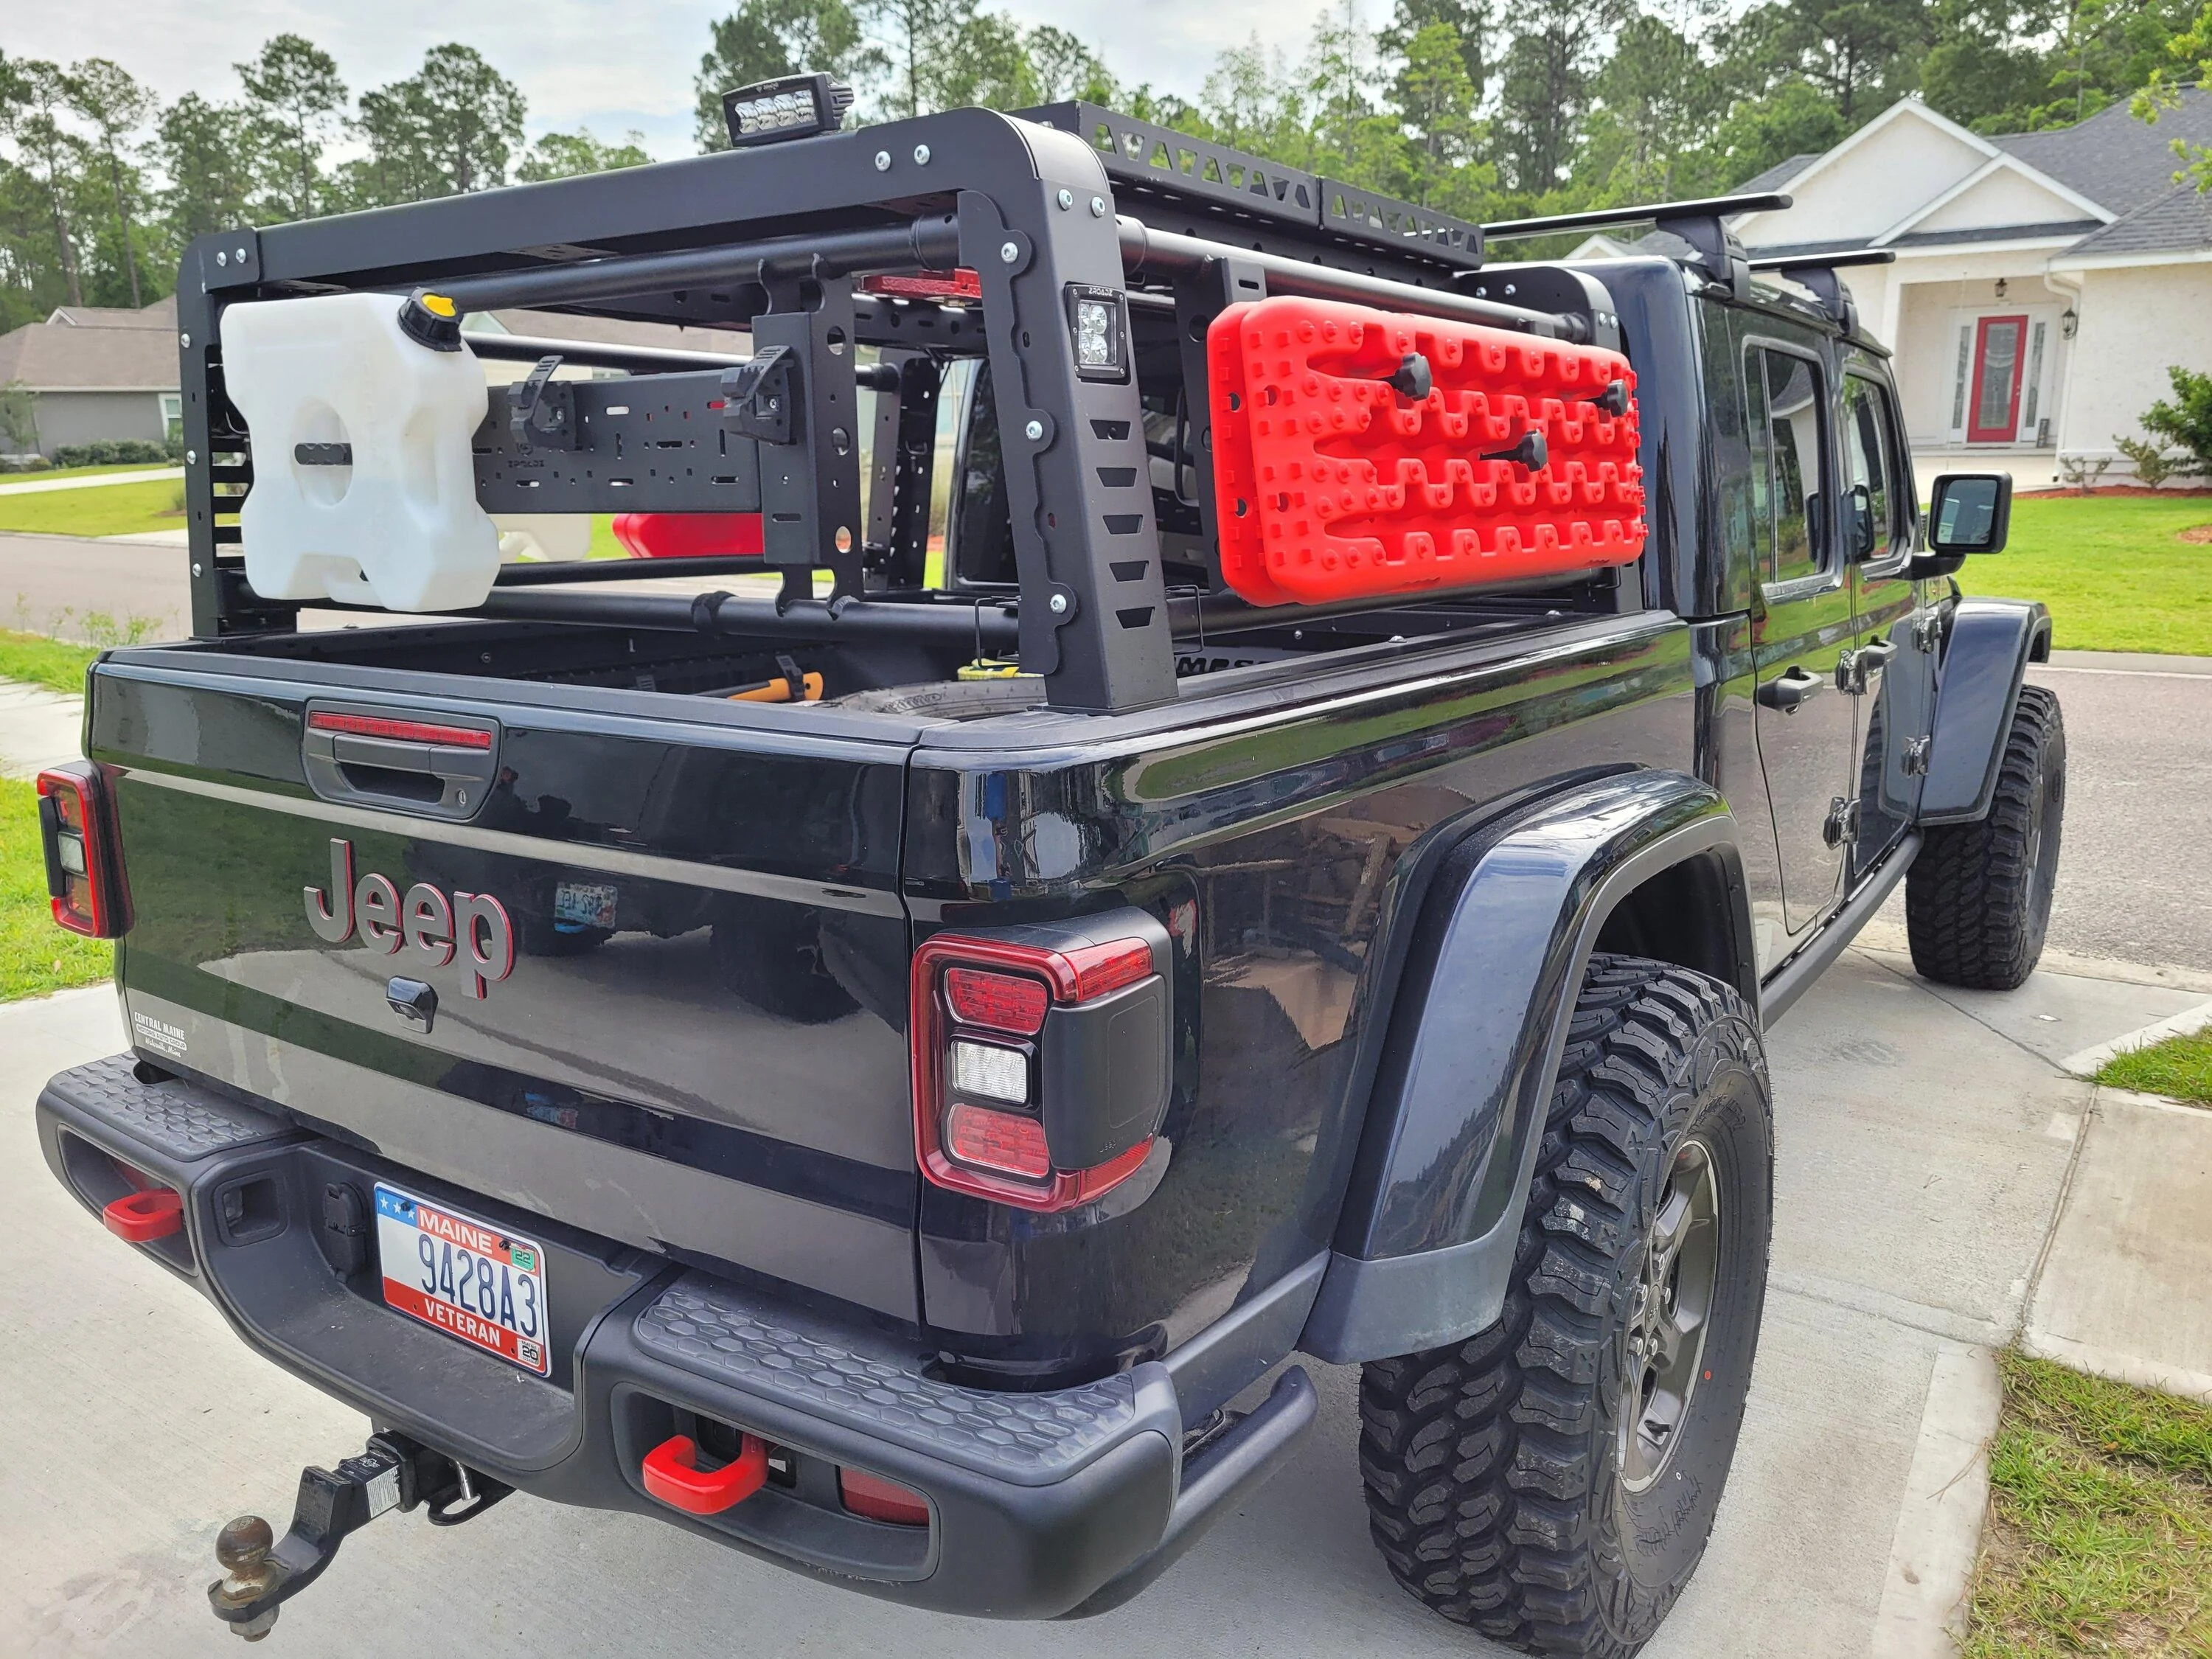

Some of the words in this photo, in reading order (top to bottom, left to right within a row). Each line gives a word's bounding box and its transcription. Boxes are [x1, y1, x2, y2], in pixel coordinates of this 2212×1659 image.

[303, 838, 514, 1001] Jeep
[134, 1011, 162, 1032] CENTRAL
[162, 1023, 185, 1040] MAINE
[419, 1208, 493, 1255] MAINE
[515, 1249, 532, 1265] 22
[418, 1234, 538, 1338] 9428A3
[424, 1298, 501, 1348] VETERAN
[522, 1345, 539, 1361] 20
